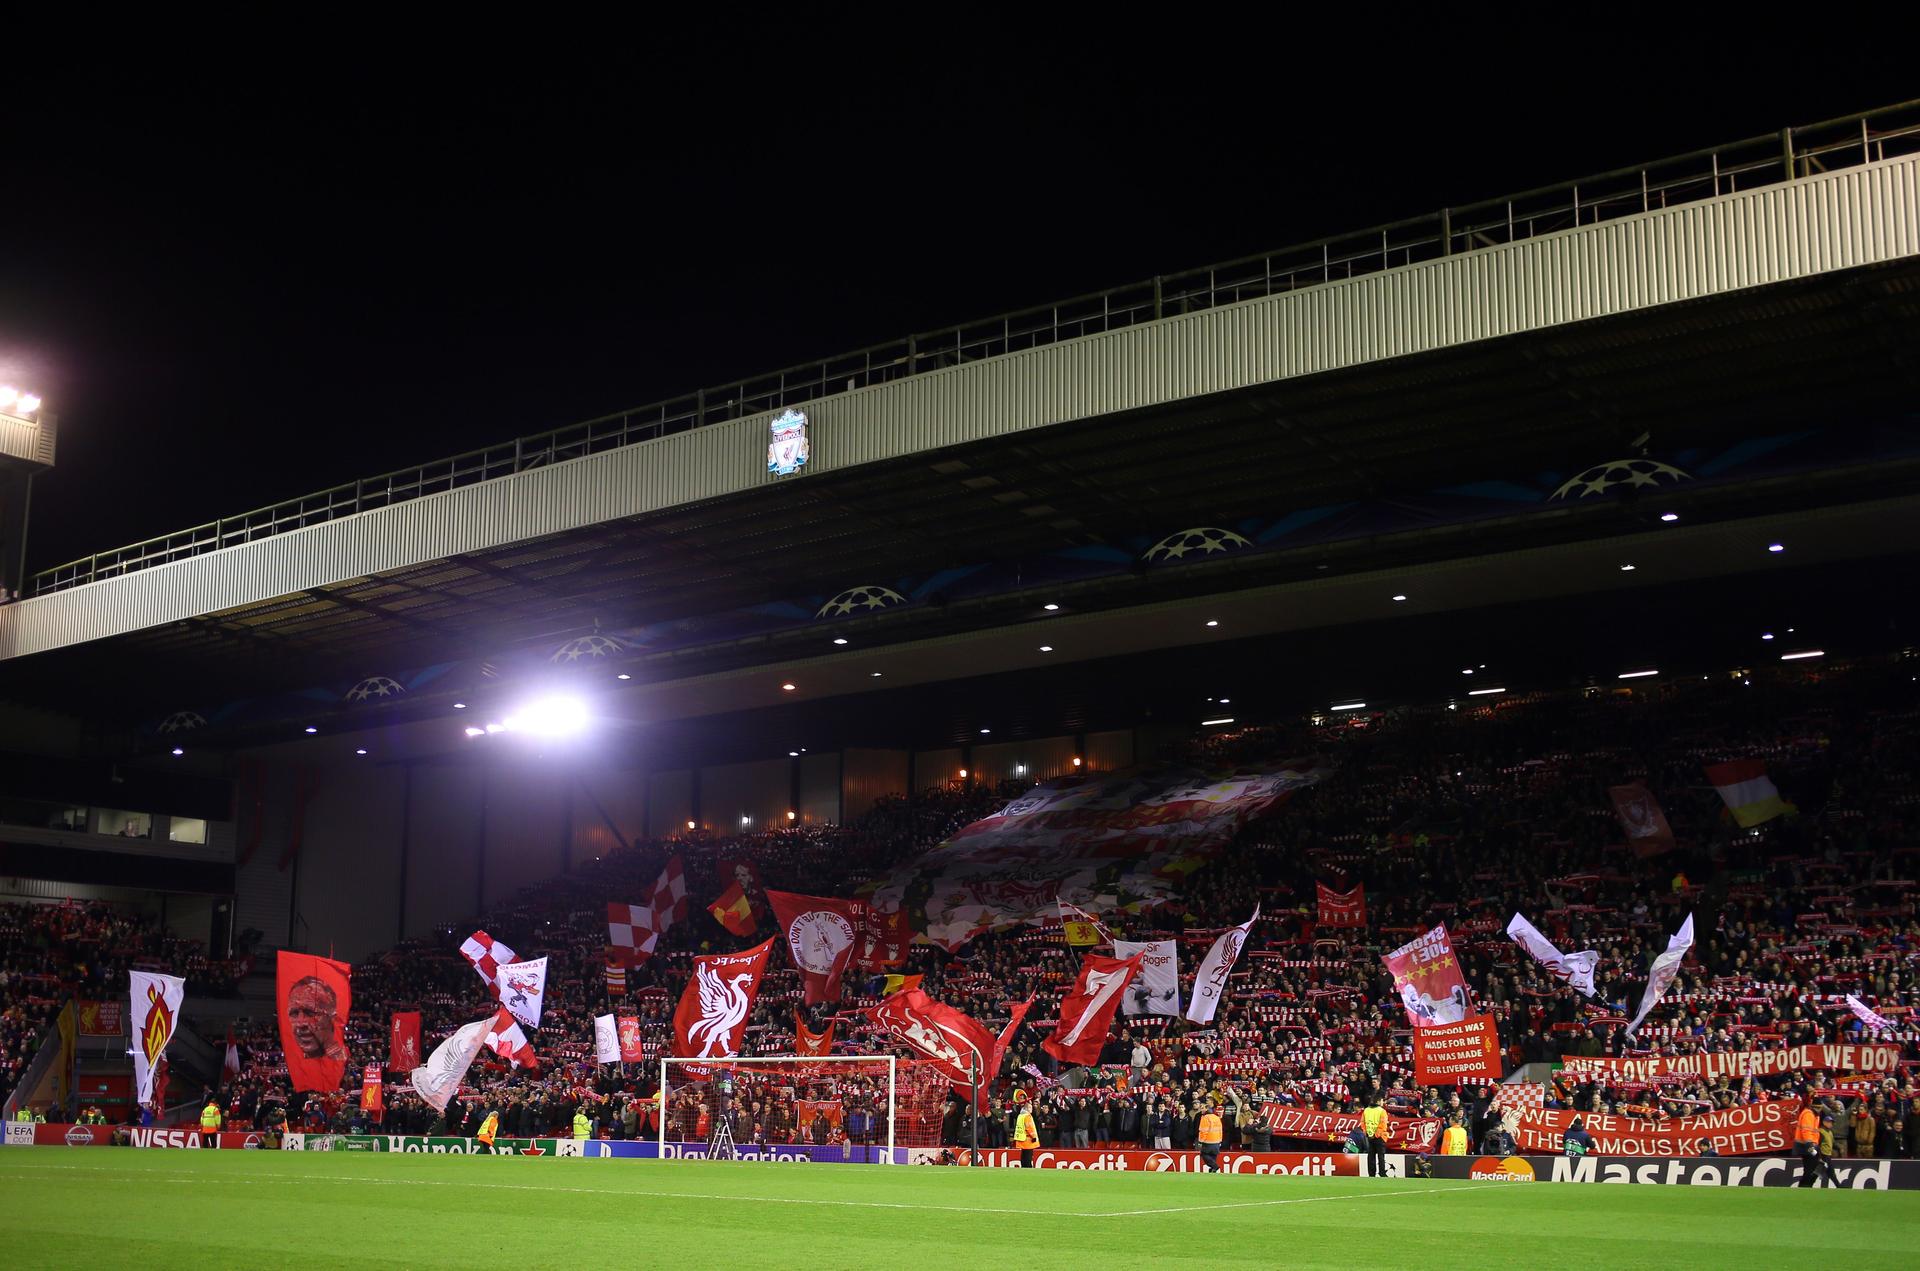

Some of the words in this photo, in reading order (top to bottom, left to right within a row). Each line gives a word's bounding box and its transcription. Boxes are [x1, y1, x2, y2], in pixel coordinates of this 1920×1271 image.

[774, 429, 801, 442] LIVERPOOL
[790, 918, 805, 944] DON'T
[823, 913, 841, 924] THE
[840, 924, 854, 941] SUN
[1147, 943, 1160, 953] Sir
[1143, 955, 1172, 967] Roger
[1058, 967, 1129, 1047] 7
[1420, 1026, 1464, 1037] LIVERPOOL
[1465, 1022, 1485, 1032] WAS
[1425, 1040, 1448, 1049] MADE
[1448, 1038, 1466, 1048] FOR
[1466, 1036, 1481, 1045] ME
[1437, 1052, 1457, 1061] WAS
[1457, 1049, 1483, 1059] MADE
[1426, 1066, 1442, 1074] FOR
[1442, 1062, 1487, 1074] LIVERPOOL
[1575, 1059, 1606, 1074] WE
[1611, 1060, 1660, 1082] LOVE
[1665, 1054, 1702, 1073] YOU
[1705, 1045, 1813, 1078] LIVERPOOL
[1823, 1044, 1855, 1070] WE
[1861, 1047, 1888, 1071] DO
[1261, 1106, 1303, 1131] ALLEZ
[1300, 1114, 1333, 1134] LES
[1523, 1108, 1560, 1127] WE
[1568, 1113, 1617, 1131] ARE
[1625, 1116, 1671, 1133] THE
[1680, 1103, 1781, 1131] FAMOUS
[6, 1126, 33, 1136] UEFA
[1523, 1129, 1564, 1151] THE
[1586, 1137, 1673, 1155] AMOUS
[1678, 1130, 1785, 1155] KOPITES
[664, 1144, 811, 1163] Playtation
[988, 1152, 1128, 1171] UnCredit
[1471, 1171, 1533, 1182] MasterCard
